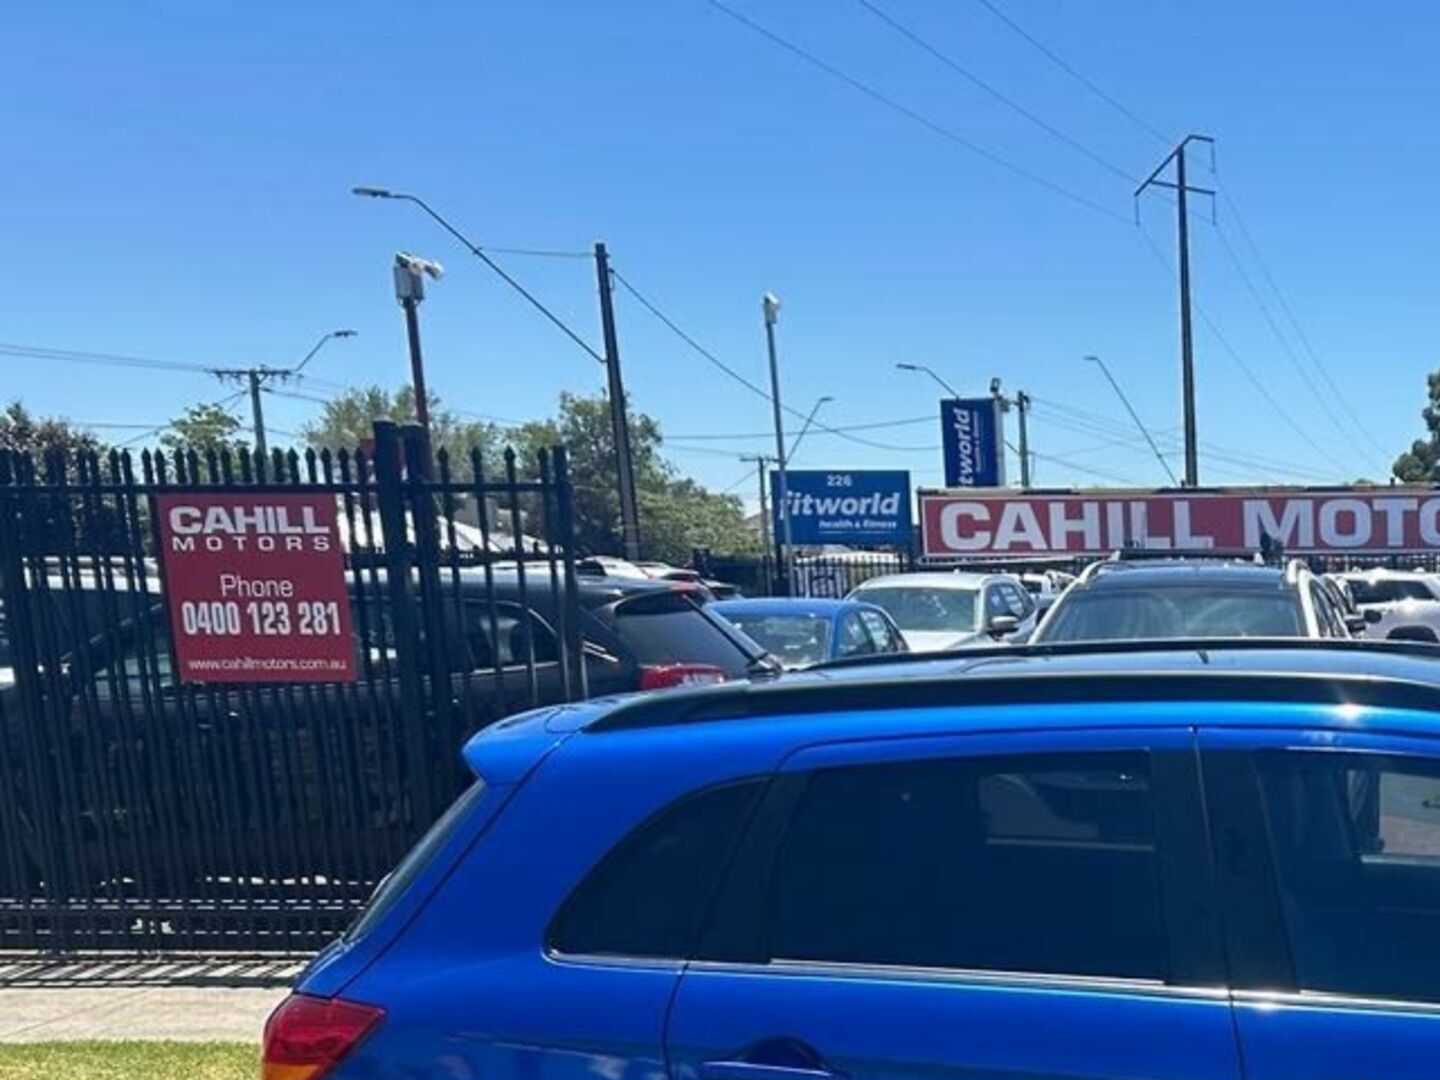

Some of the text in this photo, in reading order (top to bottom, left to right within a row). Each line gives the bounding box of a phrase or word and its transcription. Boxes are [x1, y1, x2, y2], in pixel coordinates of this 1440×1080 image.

[953, 407, 973, 485] tworld
[827, 475, 851, 487] 226
[169, 506, 330, 534] CAHILL
[940, 501, 1213, 550] CAHILL
[172, 536, 330, 551] MOTORS
[220, 574, 293, 597] Phone
[181, 602, 340, 635] 0400 123 281
[188, 657, 346, 670] www.cahillmotors.com.au
